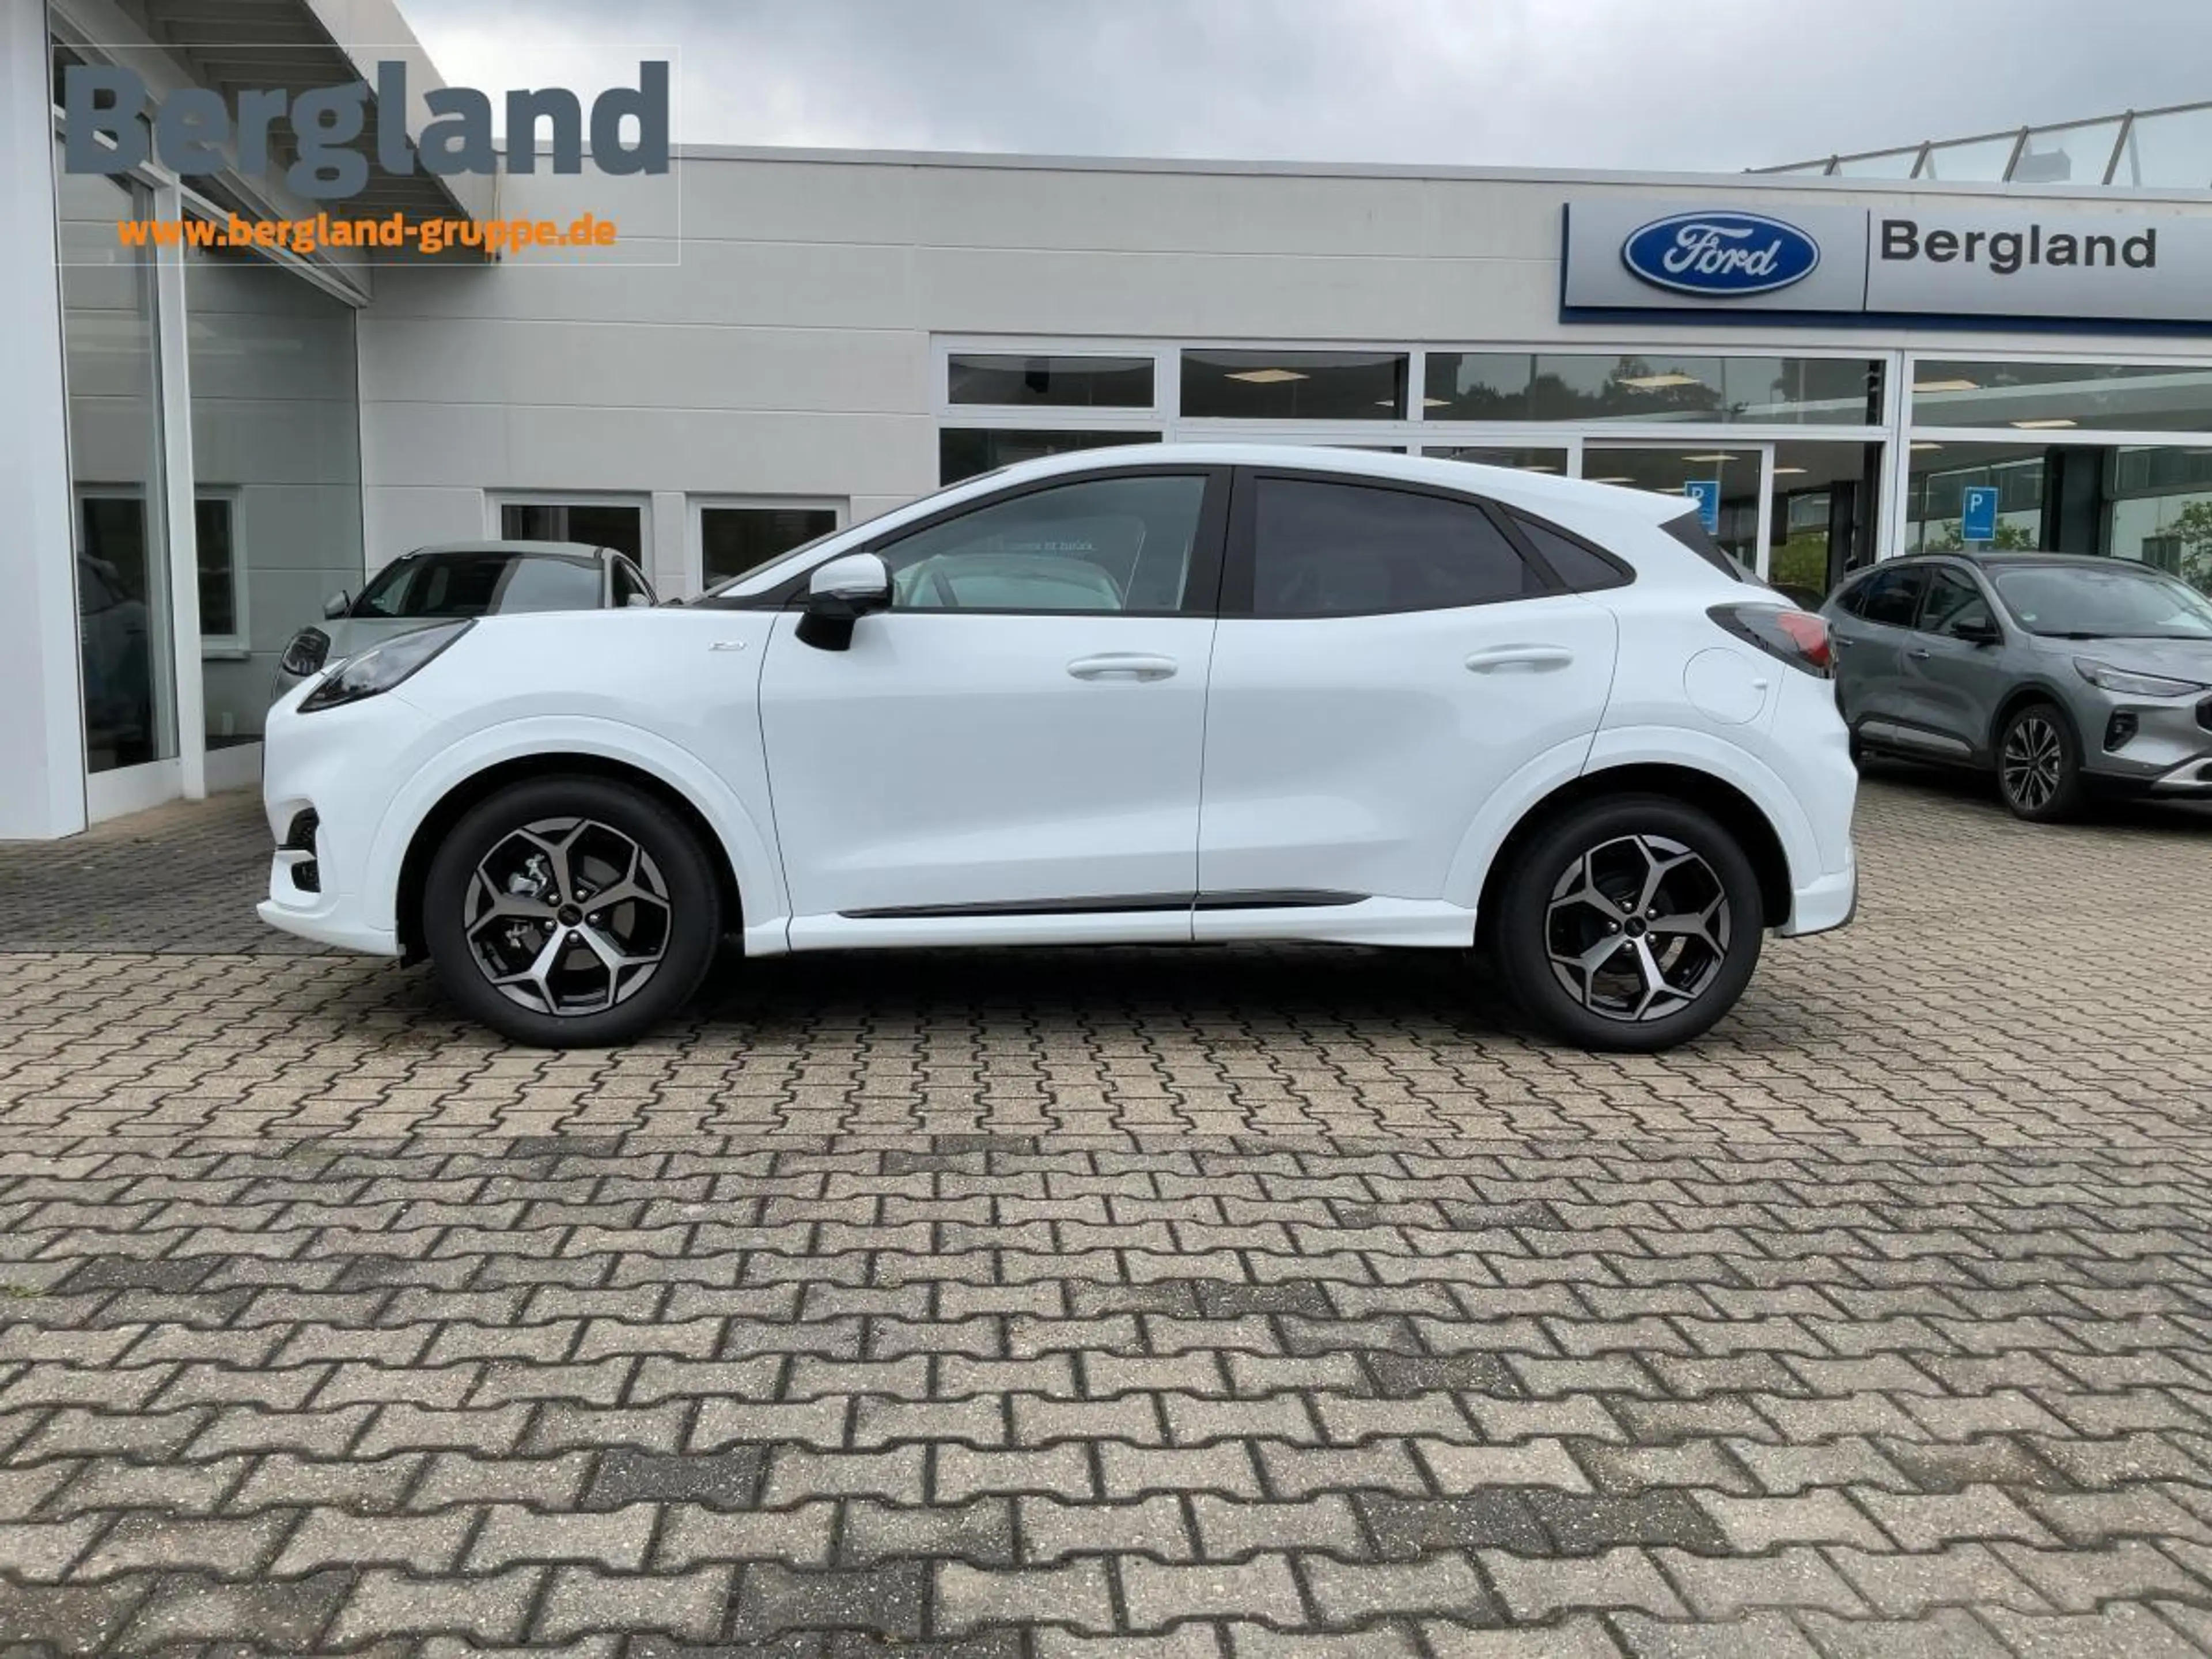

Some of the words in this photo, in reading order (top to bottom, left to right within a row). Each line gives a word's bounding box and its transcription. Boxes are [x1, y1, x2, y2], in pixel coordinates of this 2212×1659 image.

[1663, 224, 1783, 276] Ford
[1881, 219, 2156, 274] Bergland
[1971, 494, 1983, 514] P
